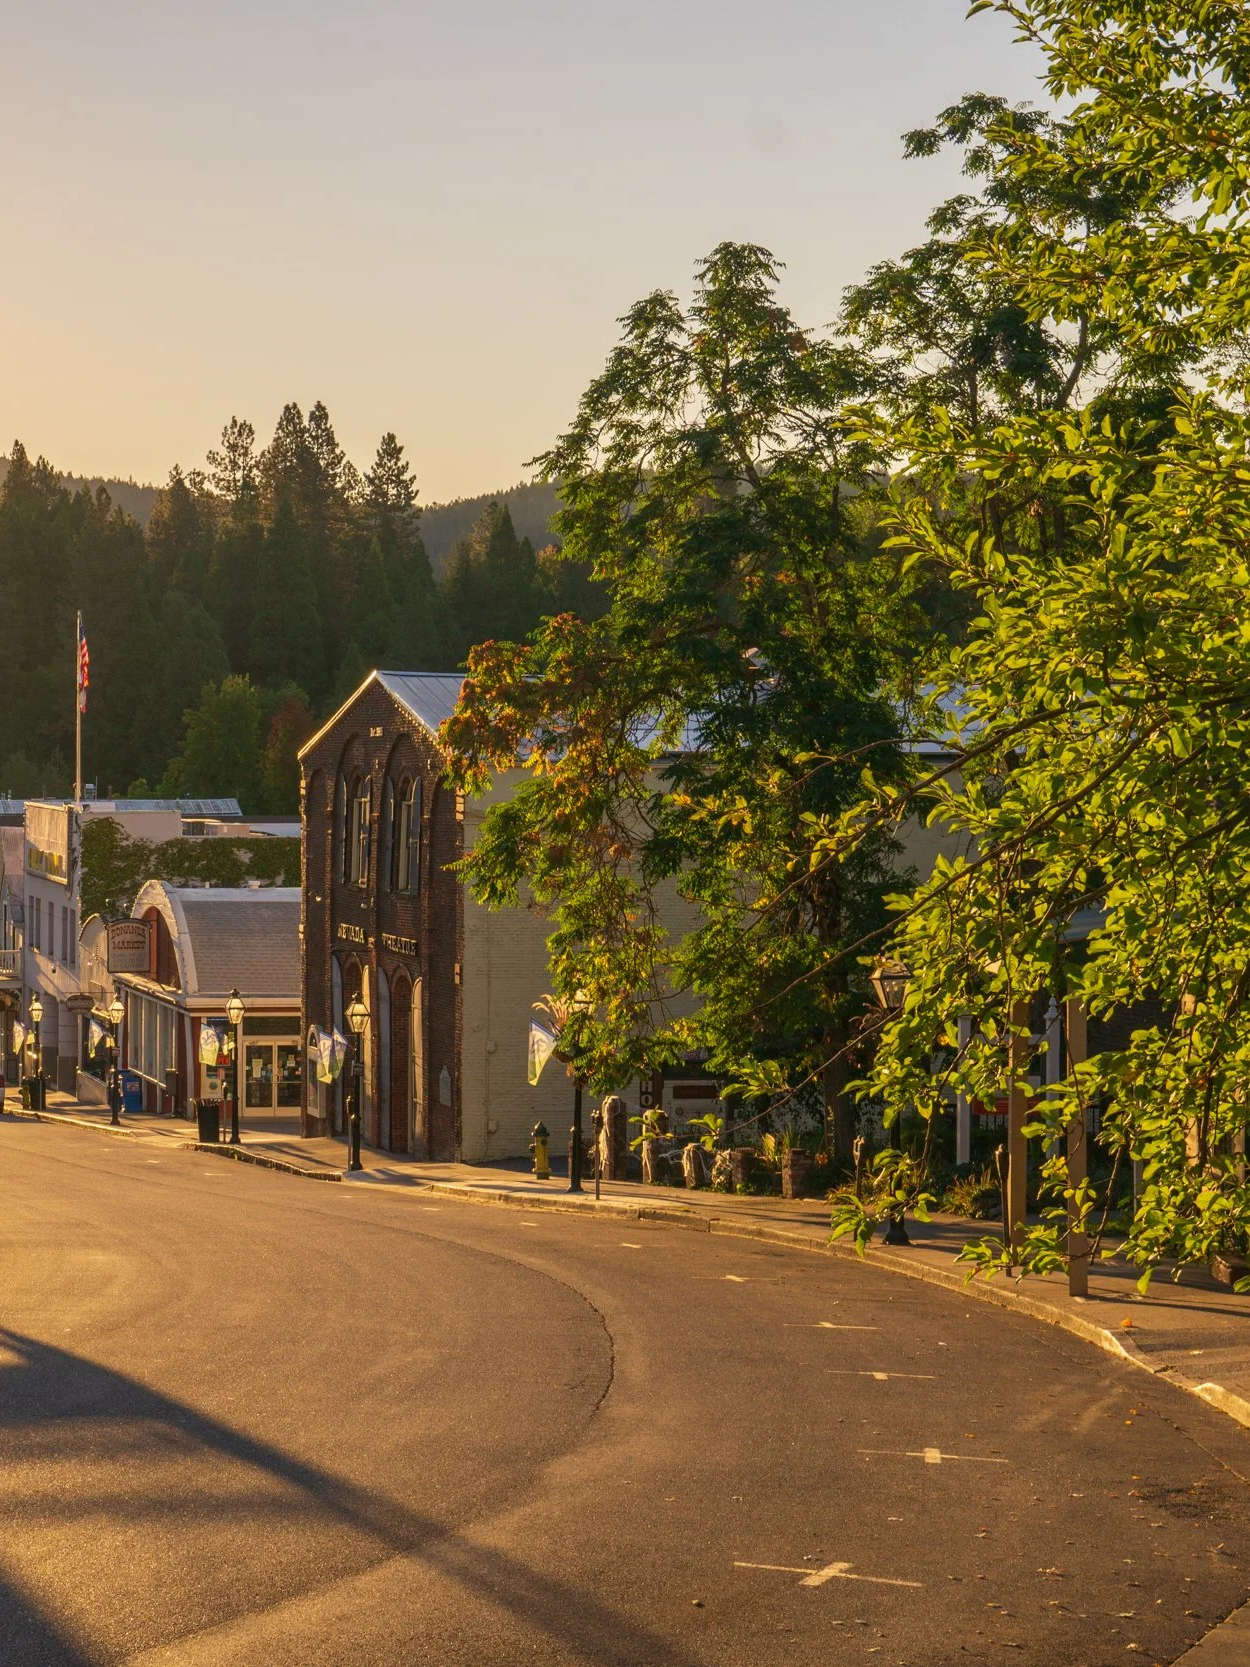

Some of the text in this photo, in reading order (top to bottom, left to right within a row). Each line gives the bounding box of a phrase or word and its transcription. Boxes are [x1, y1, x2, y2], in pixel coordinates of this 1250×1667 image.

[111, 925, 146, 940] BONANZA
[337, 923, 417, 956] NEVADA THEATRE
[112, 940, 146, 949] MARKET
